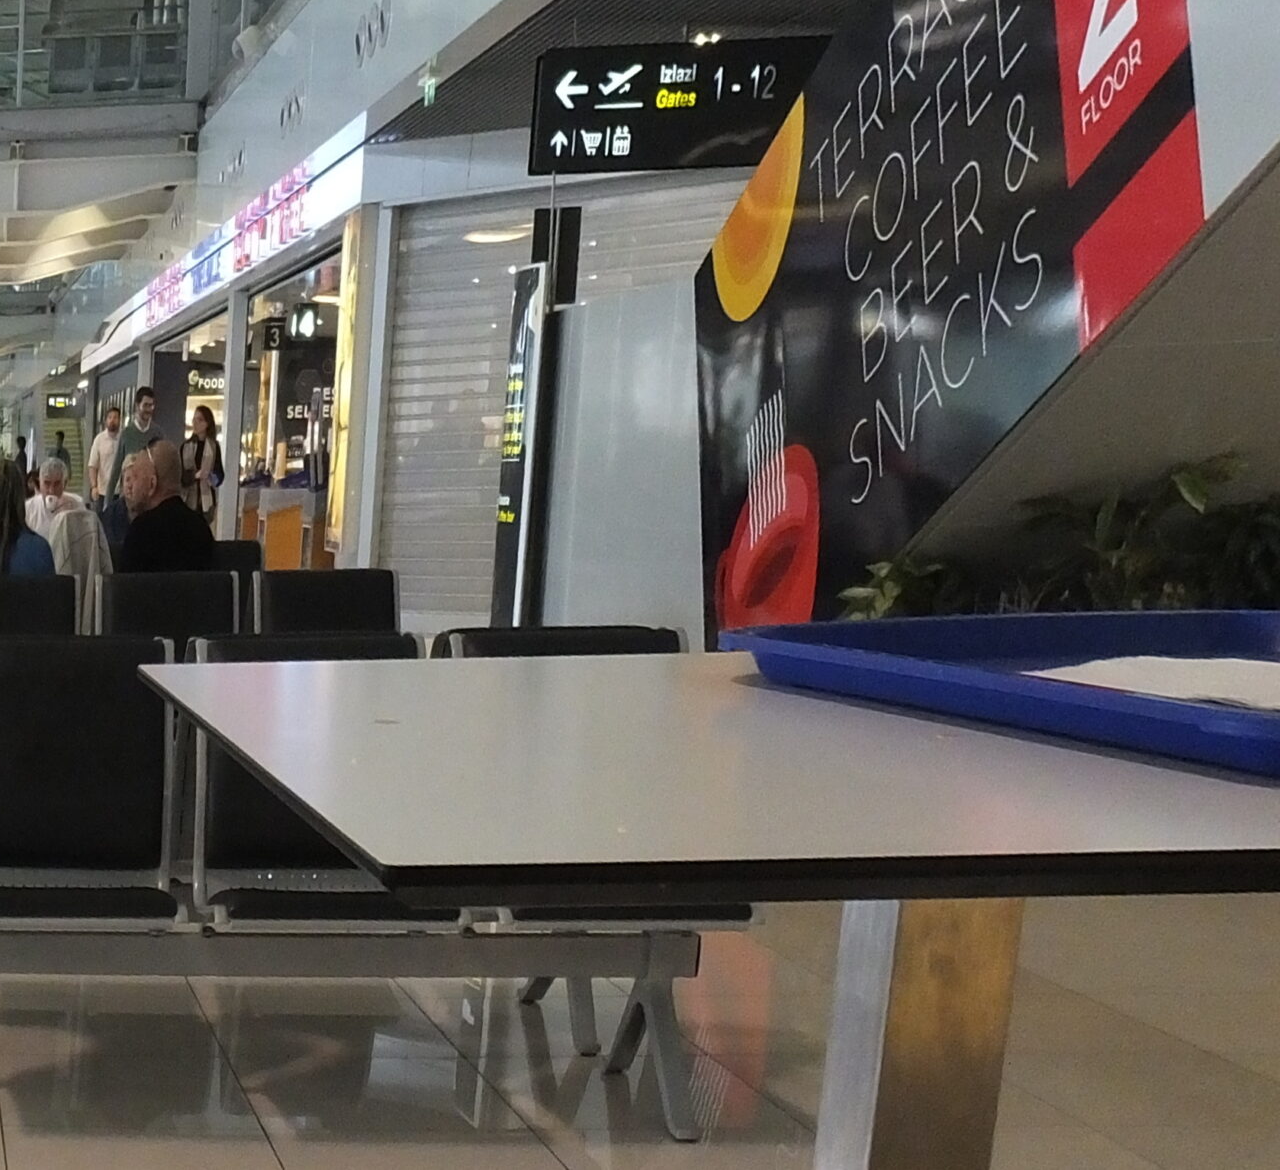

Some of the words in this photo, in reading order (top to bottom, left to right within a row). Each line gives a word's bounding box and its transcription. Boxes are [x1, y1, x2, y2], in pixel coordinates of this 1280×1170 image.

[655, 88, 697, 110] Gates
[659, 63, 697, 84] Izlazi
[714, 65, 724, 102] 1
[750, 64, 778, 99] 12
[1081, 37, 1143, 136] FLOOR
[861, 160, 983, 383] BEER
[1004, 93, 1039, 193] &
[270, 327, 280, 347] 3
[849, 207, 1043, 504] SNACKS
